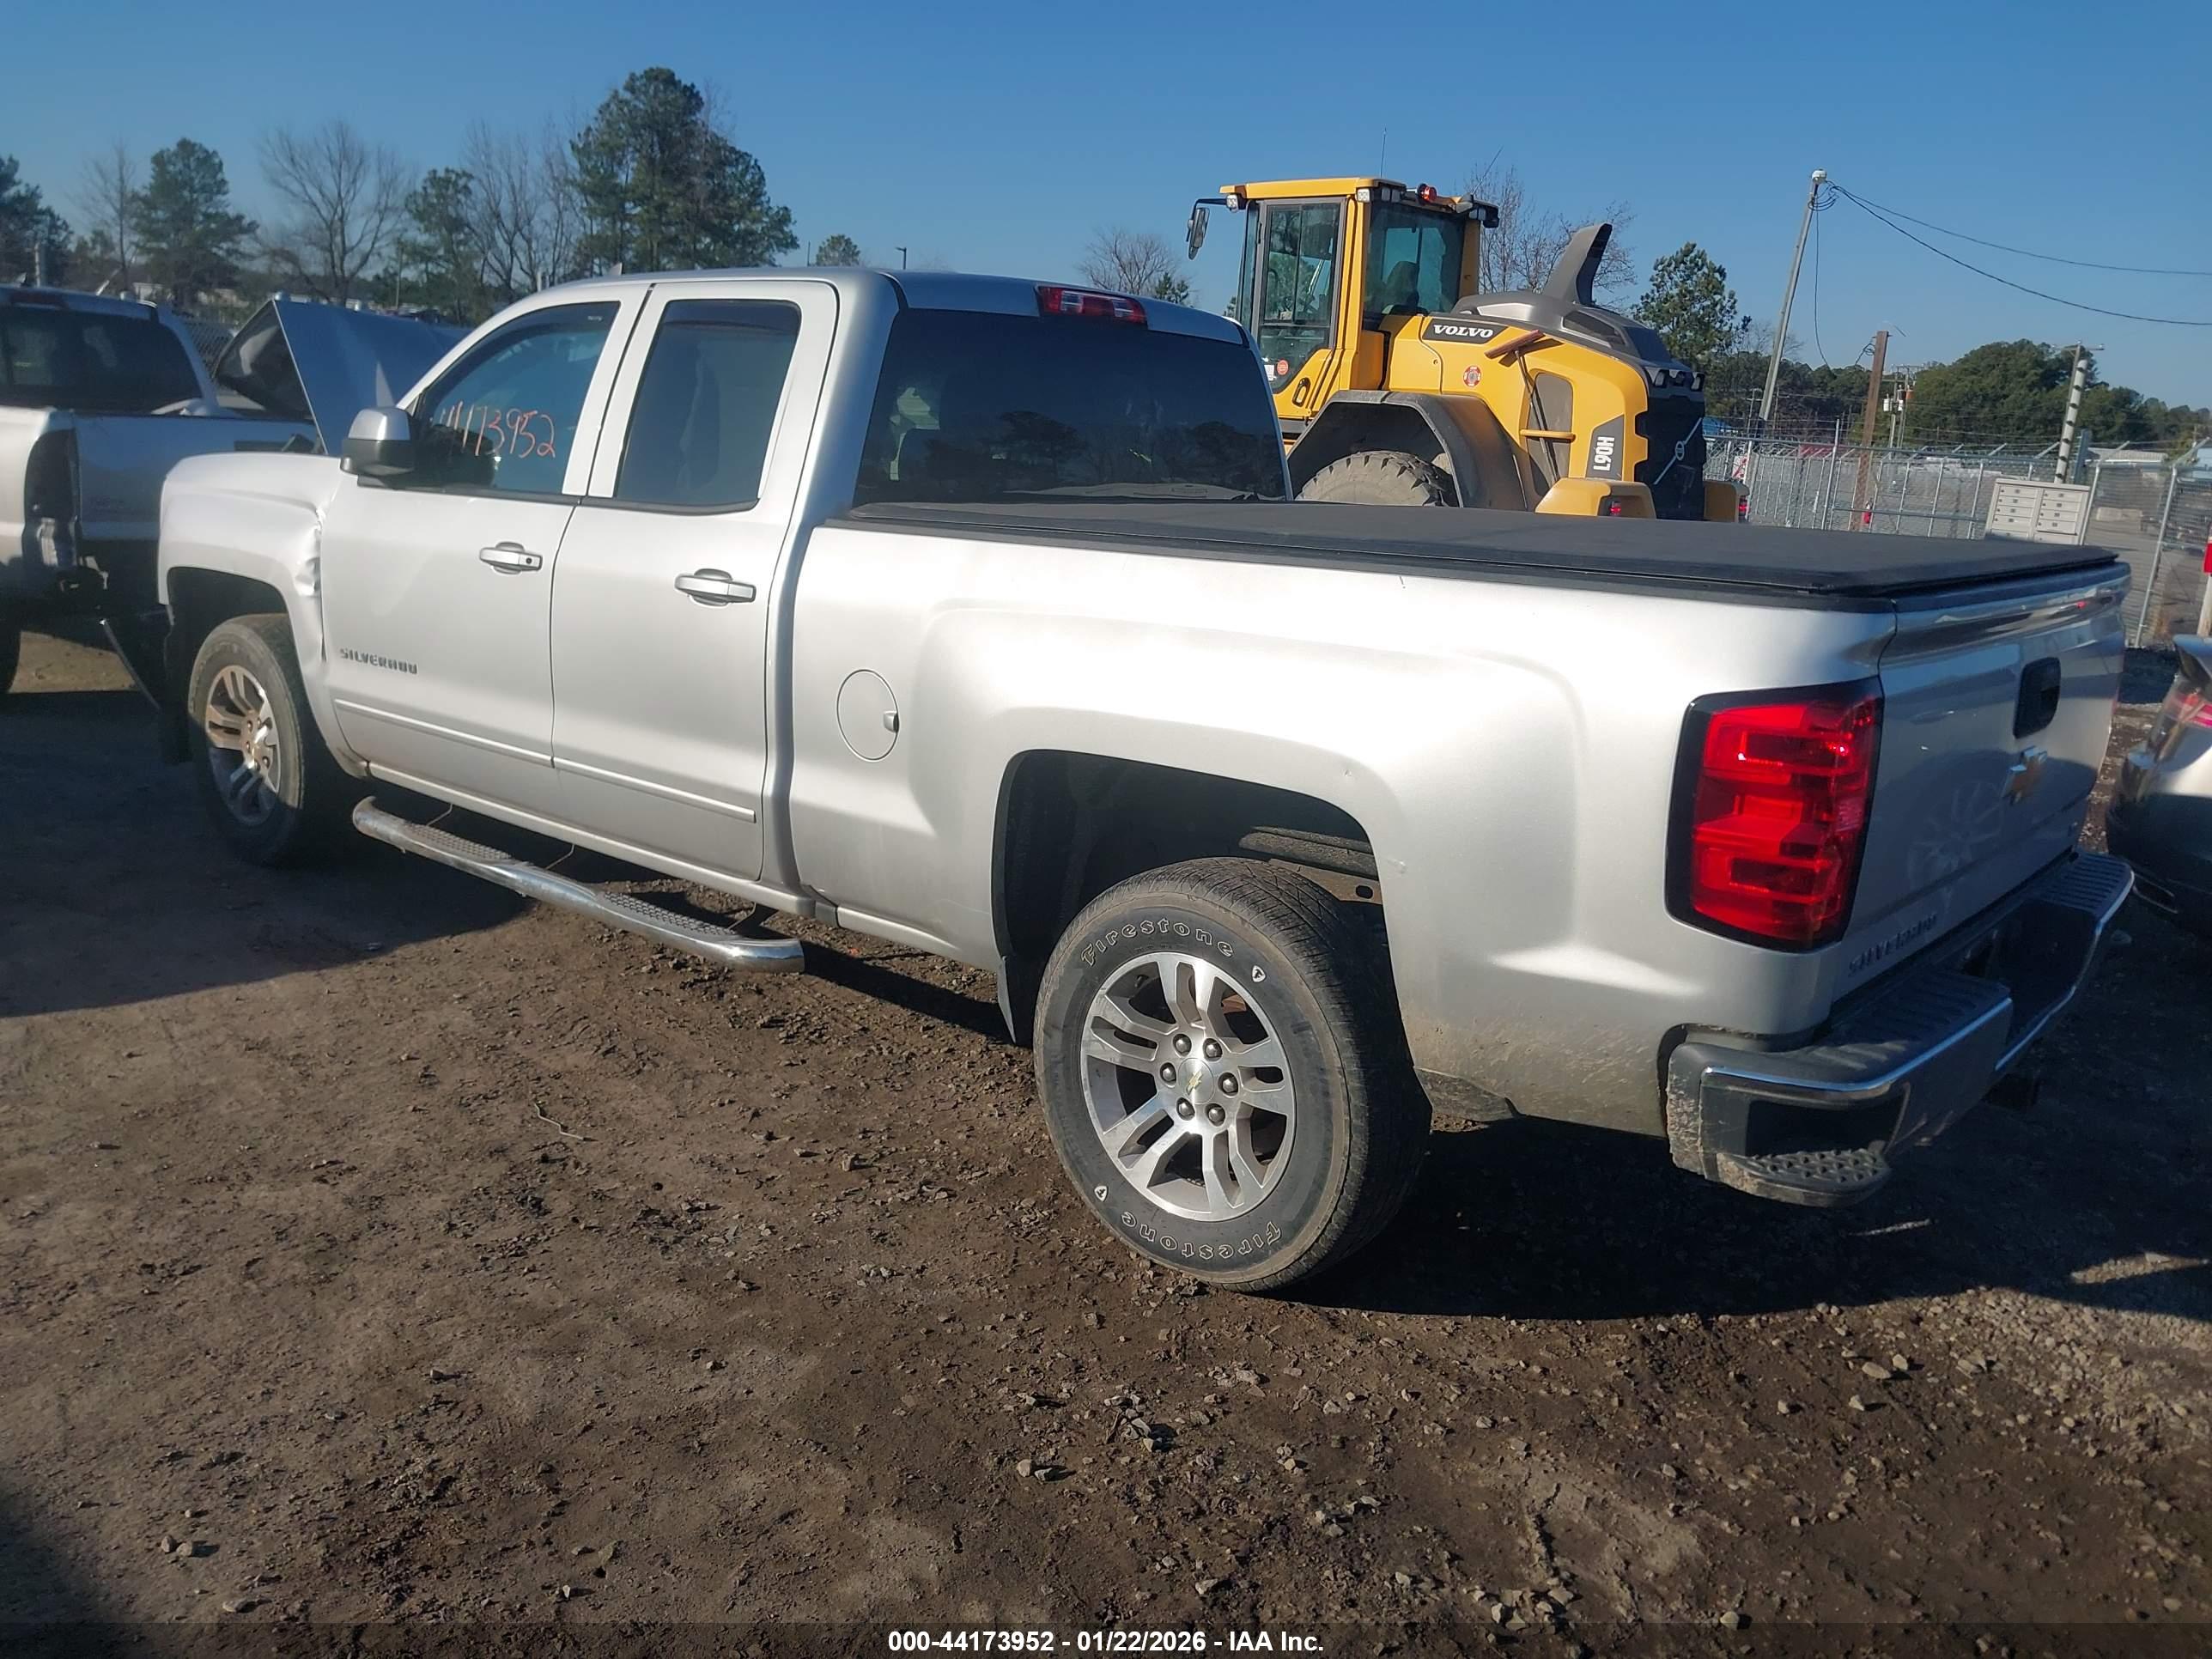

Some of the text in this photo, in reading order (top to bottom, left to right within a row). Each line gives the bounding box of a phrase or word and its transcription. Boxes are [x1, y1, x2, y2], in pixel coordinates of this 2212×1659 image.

[1433, 325, 1493, 338] VOLVO
[1593, 436, 1615, 471] L90H
[1080, 918, 1235, 967] Firestone
[1121, 1211, 1283, 1261] Firestone
